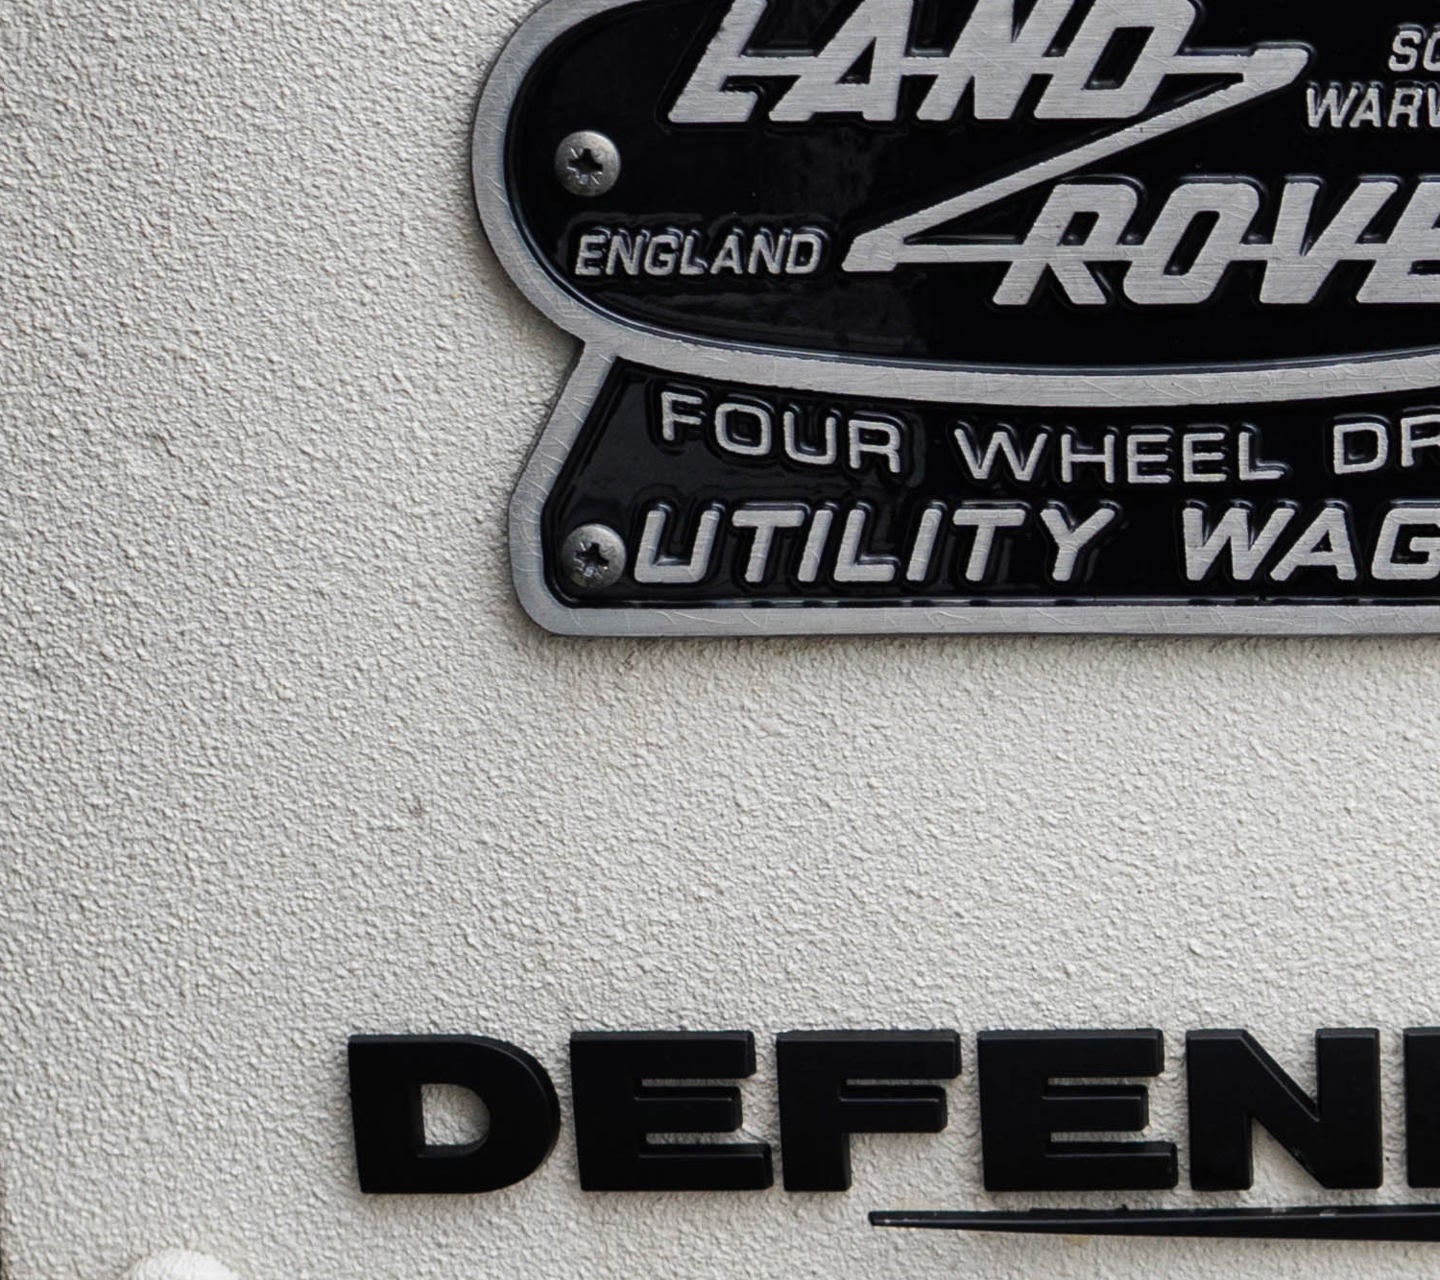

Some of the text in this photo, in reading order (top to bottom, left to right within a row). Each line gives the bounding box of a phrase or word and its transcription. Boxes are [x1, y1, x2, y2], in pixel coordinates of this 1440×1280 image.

[574, 234, 823, 277] ENGLAND
[659, 391, 902, 474] FOUR
[954, 428, 1282, 485] WHEEL
[633, 507, 1116, 585] UTILITY
